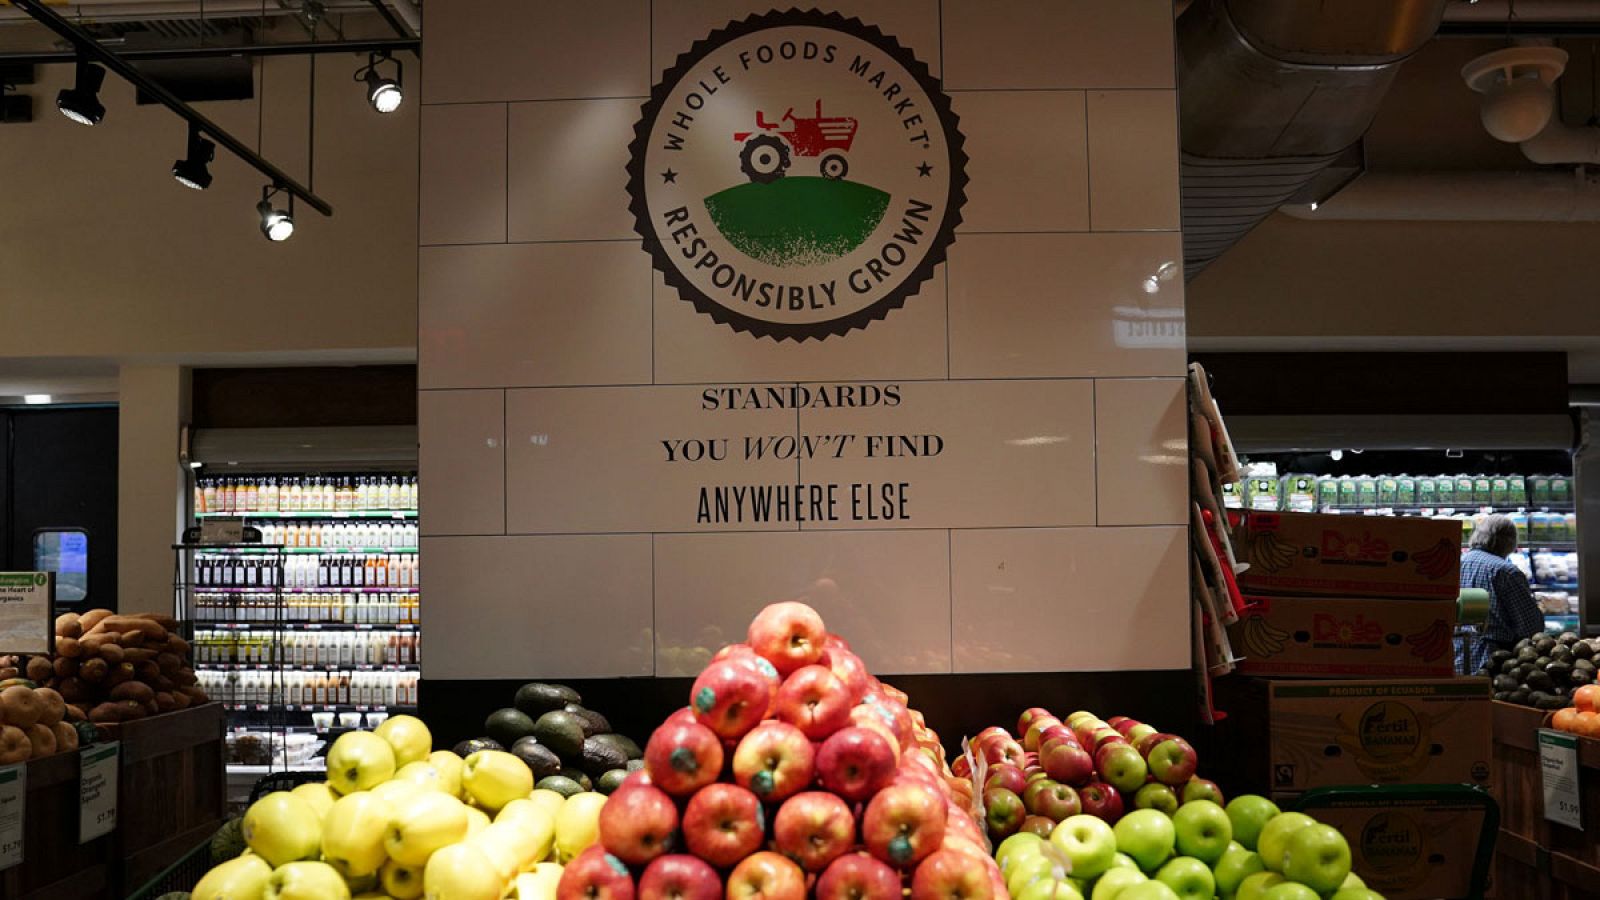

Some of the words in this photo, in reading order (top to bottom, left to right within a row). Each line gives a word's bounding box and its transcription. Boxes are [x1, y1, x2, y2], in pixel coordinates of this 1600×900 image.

[664, 65, 730, 151] WHOLE
[739, 41, 837, 70] FOODS
[664, 206, 837, 310] RESPONSIBLY
[849, 199, 932, 293] GROWN
[702, 384, 901, 410] STANDARDS
[661, 439, 729, 461] YOU
[744, 435, 855, 460] WON'T
[864, 434, 944, 457] FIND
[697, 484, 838, 523] ANYWHERE
[851, 483, 910, 520] ELSE
[1321, 530, 1390, 560] Dole
[1313, 614, 1383, 643] Dole
[1329, 687, 1373, 696] PRODUCT
[1376, 687, 1388, 696] OF
[1391, 687, 1436, 695] ECUADOR
